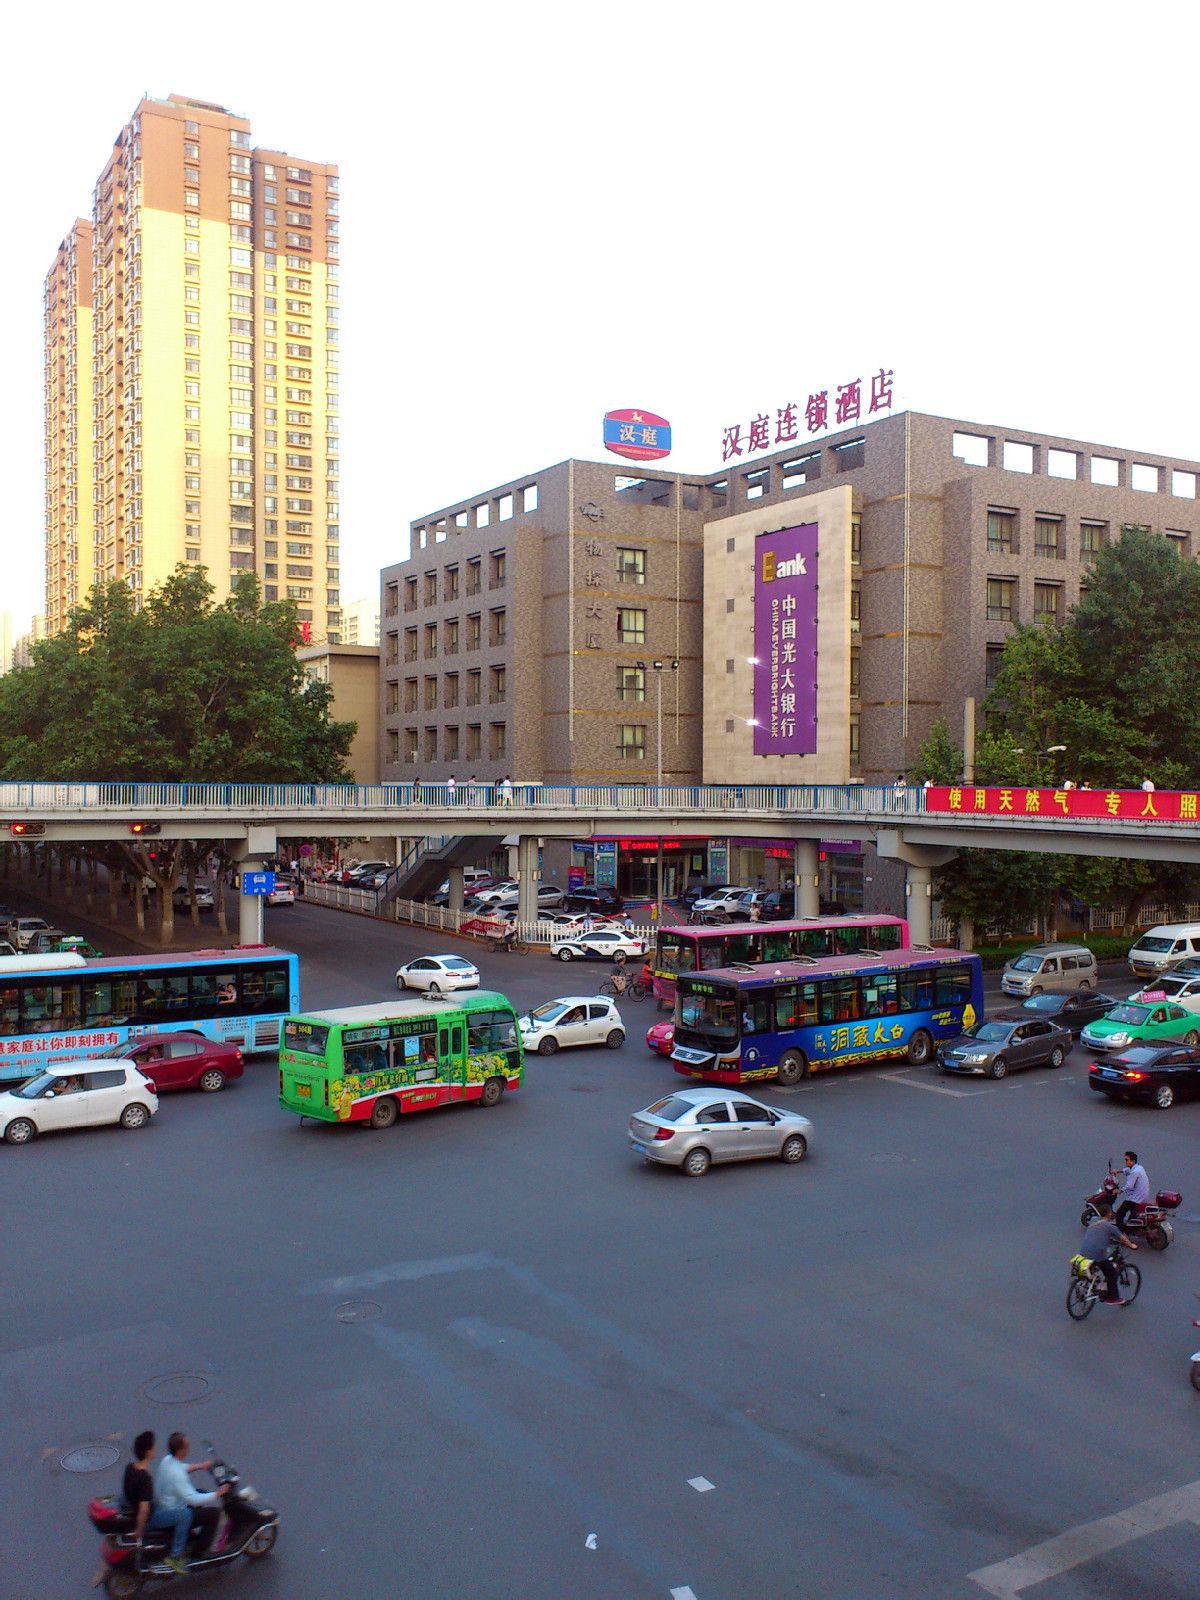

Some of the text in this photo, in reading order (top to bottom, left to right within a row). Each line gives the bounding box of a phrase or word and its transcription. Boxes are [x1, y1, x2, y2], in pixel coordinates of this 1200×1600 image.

[722, 368, 894, 462] 汉庭连锁酒店
[620, 424, 657, 446] 汉庭
[781, 594, 796, 738] 中国光大银行
[948, 788, 1198, 819] 使用天然气 专人照
[831, 1021, 904, 1052] 洞藏太白
